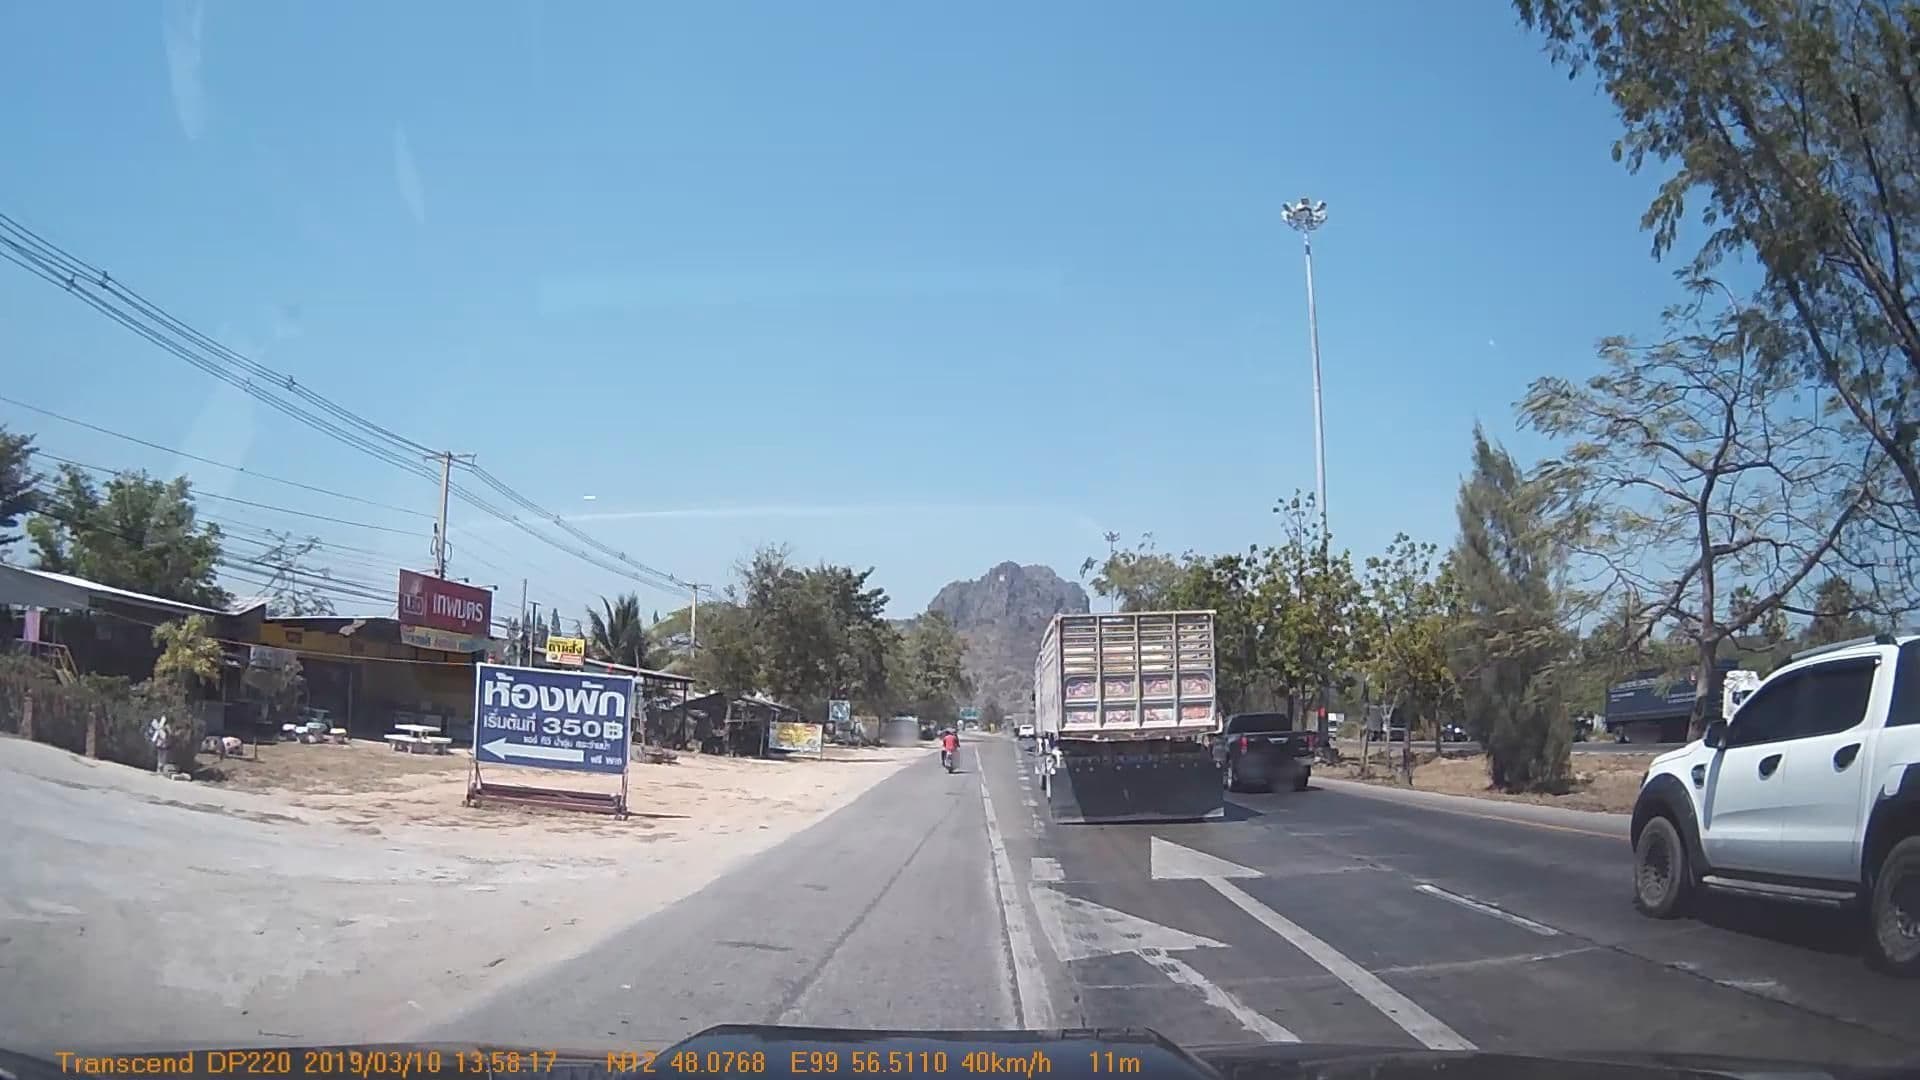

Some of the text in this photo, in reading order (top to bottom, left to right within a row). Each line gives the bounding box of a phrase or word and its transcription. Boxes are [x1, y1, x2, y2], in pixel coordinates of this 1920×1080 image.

[484, 672, 626, 718] ห้องพัก
[483, 708, 537, 733] เริ่มต้นที่
